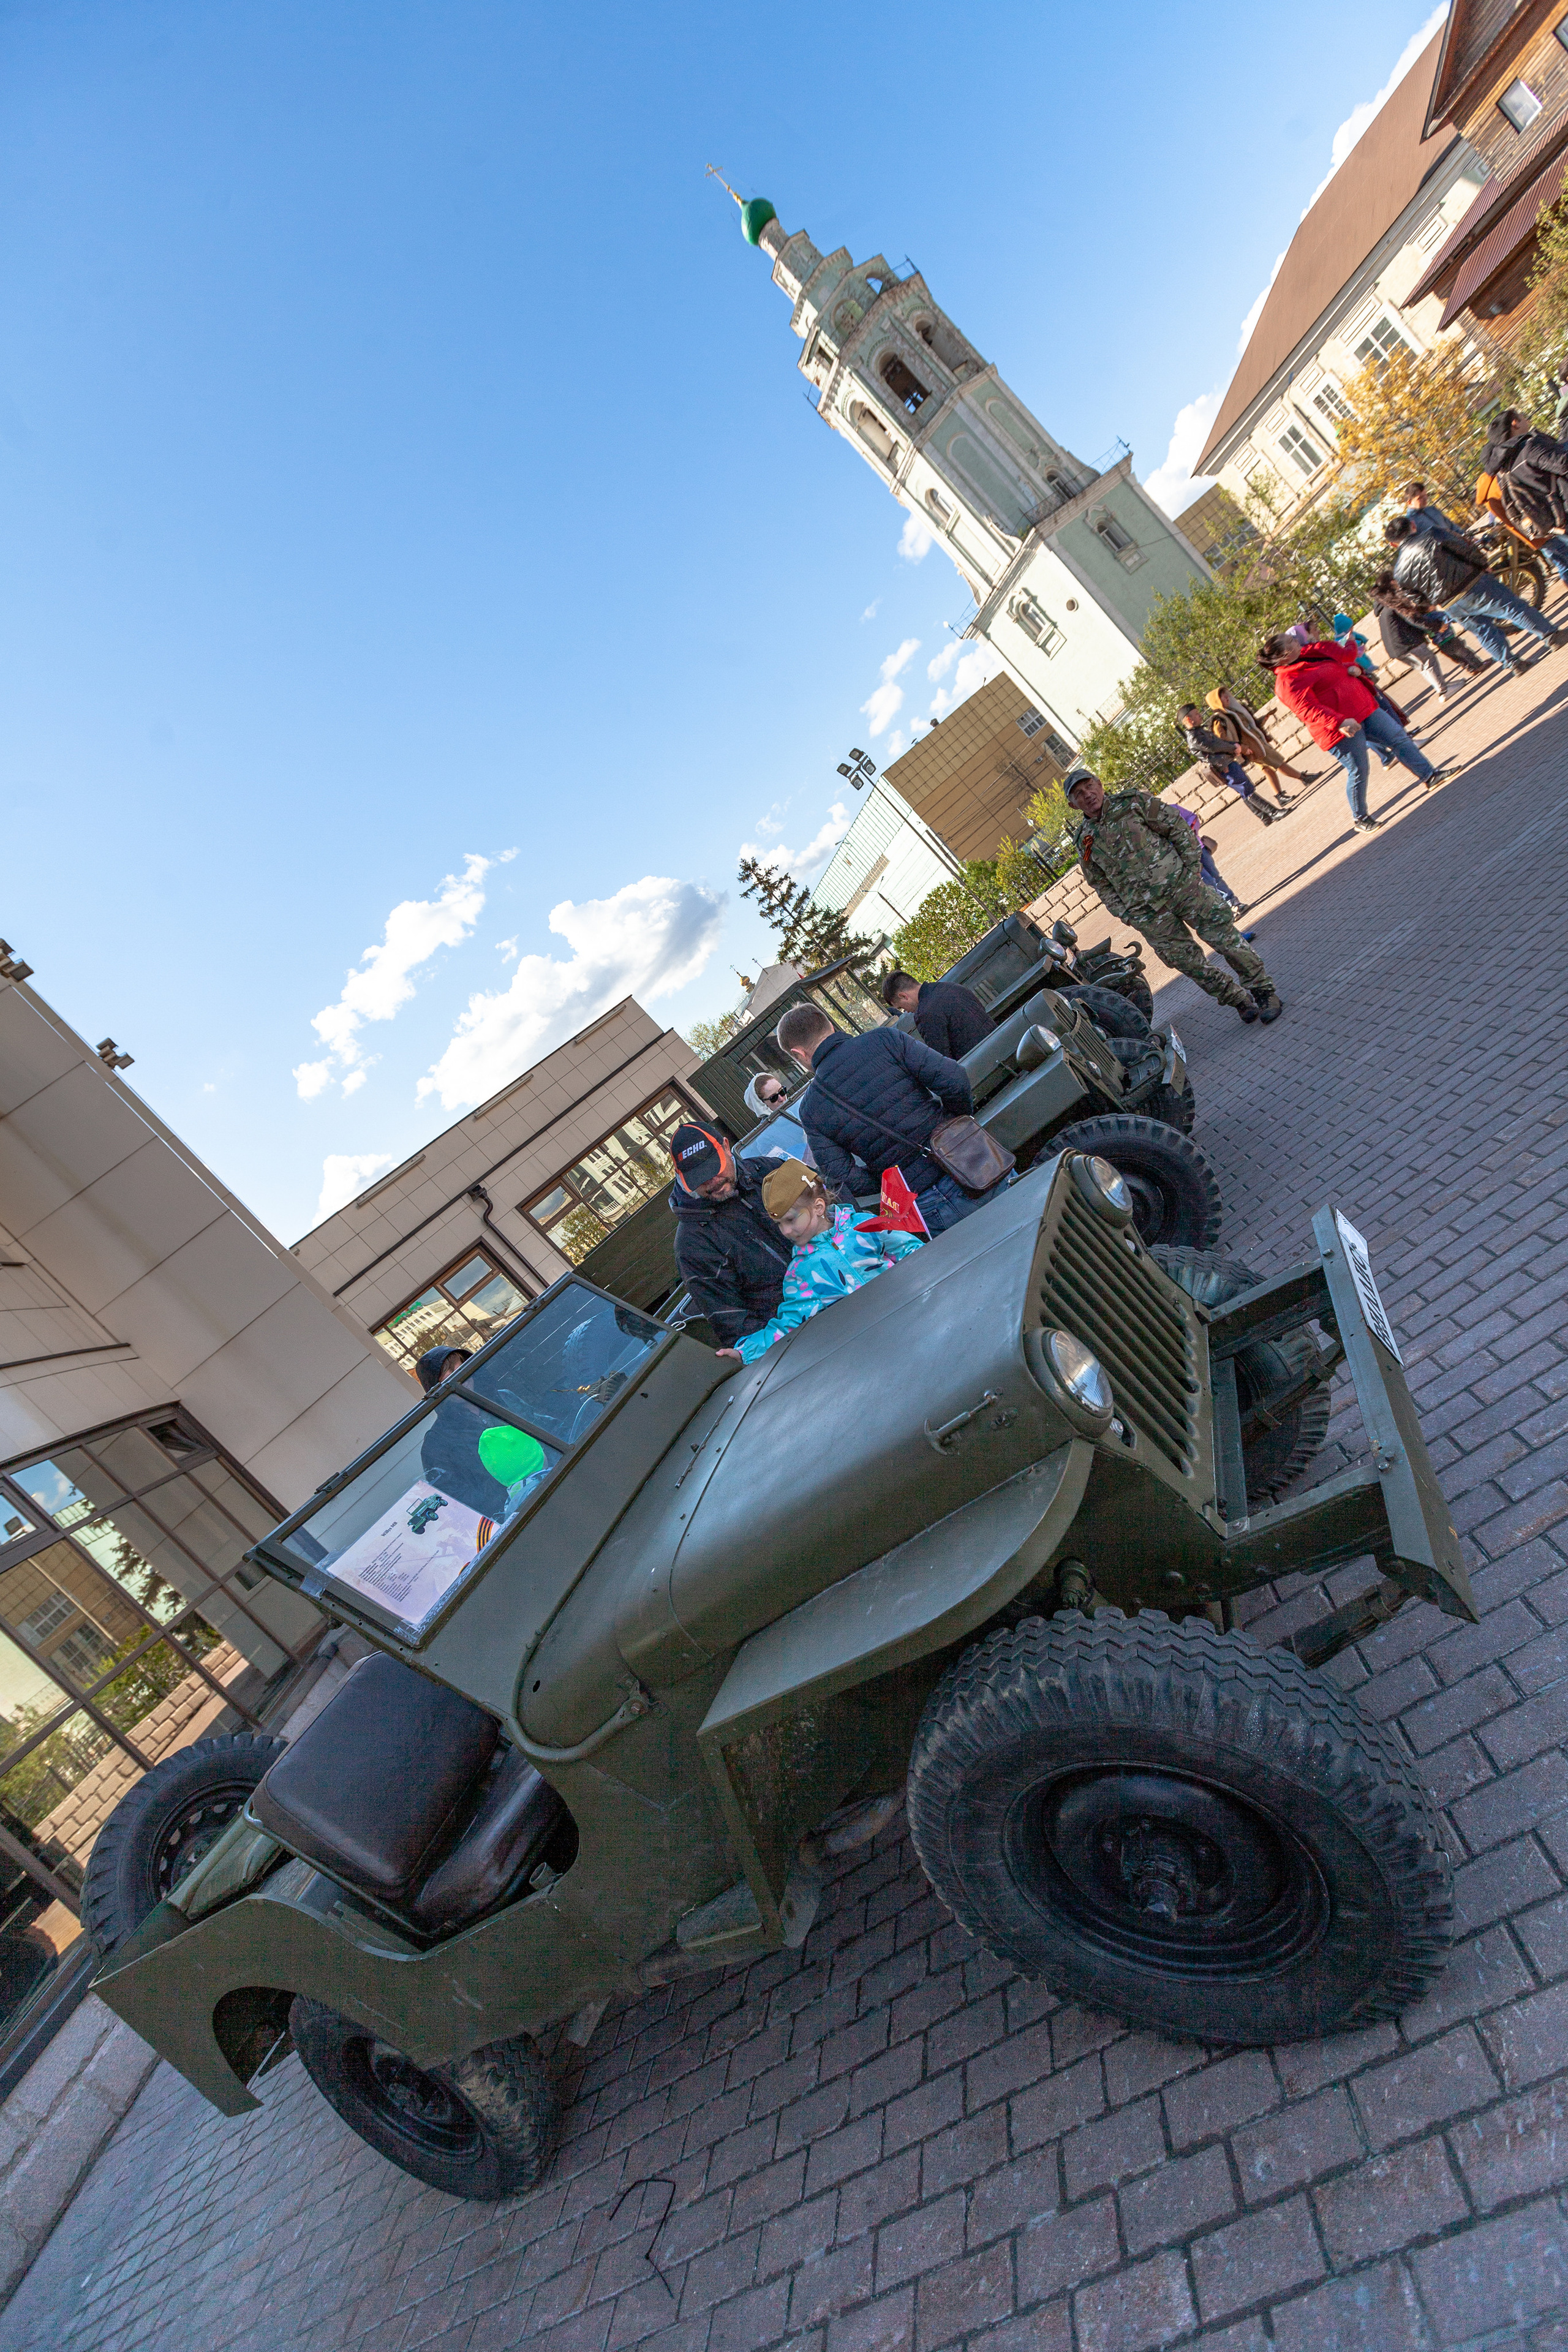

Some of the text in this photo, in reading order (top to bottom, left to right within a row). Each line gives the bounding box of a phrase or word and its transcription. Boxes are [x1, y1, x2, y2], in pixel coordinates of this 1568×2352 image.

[682, 1140, 705, 1159] ECHO
[1349, 1245, 1397, 1357] ВИЛЛИС
[381, 1527, 392, 1537] Willys
